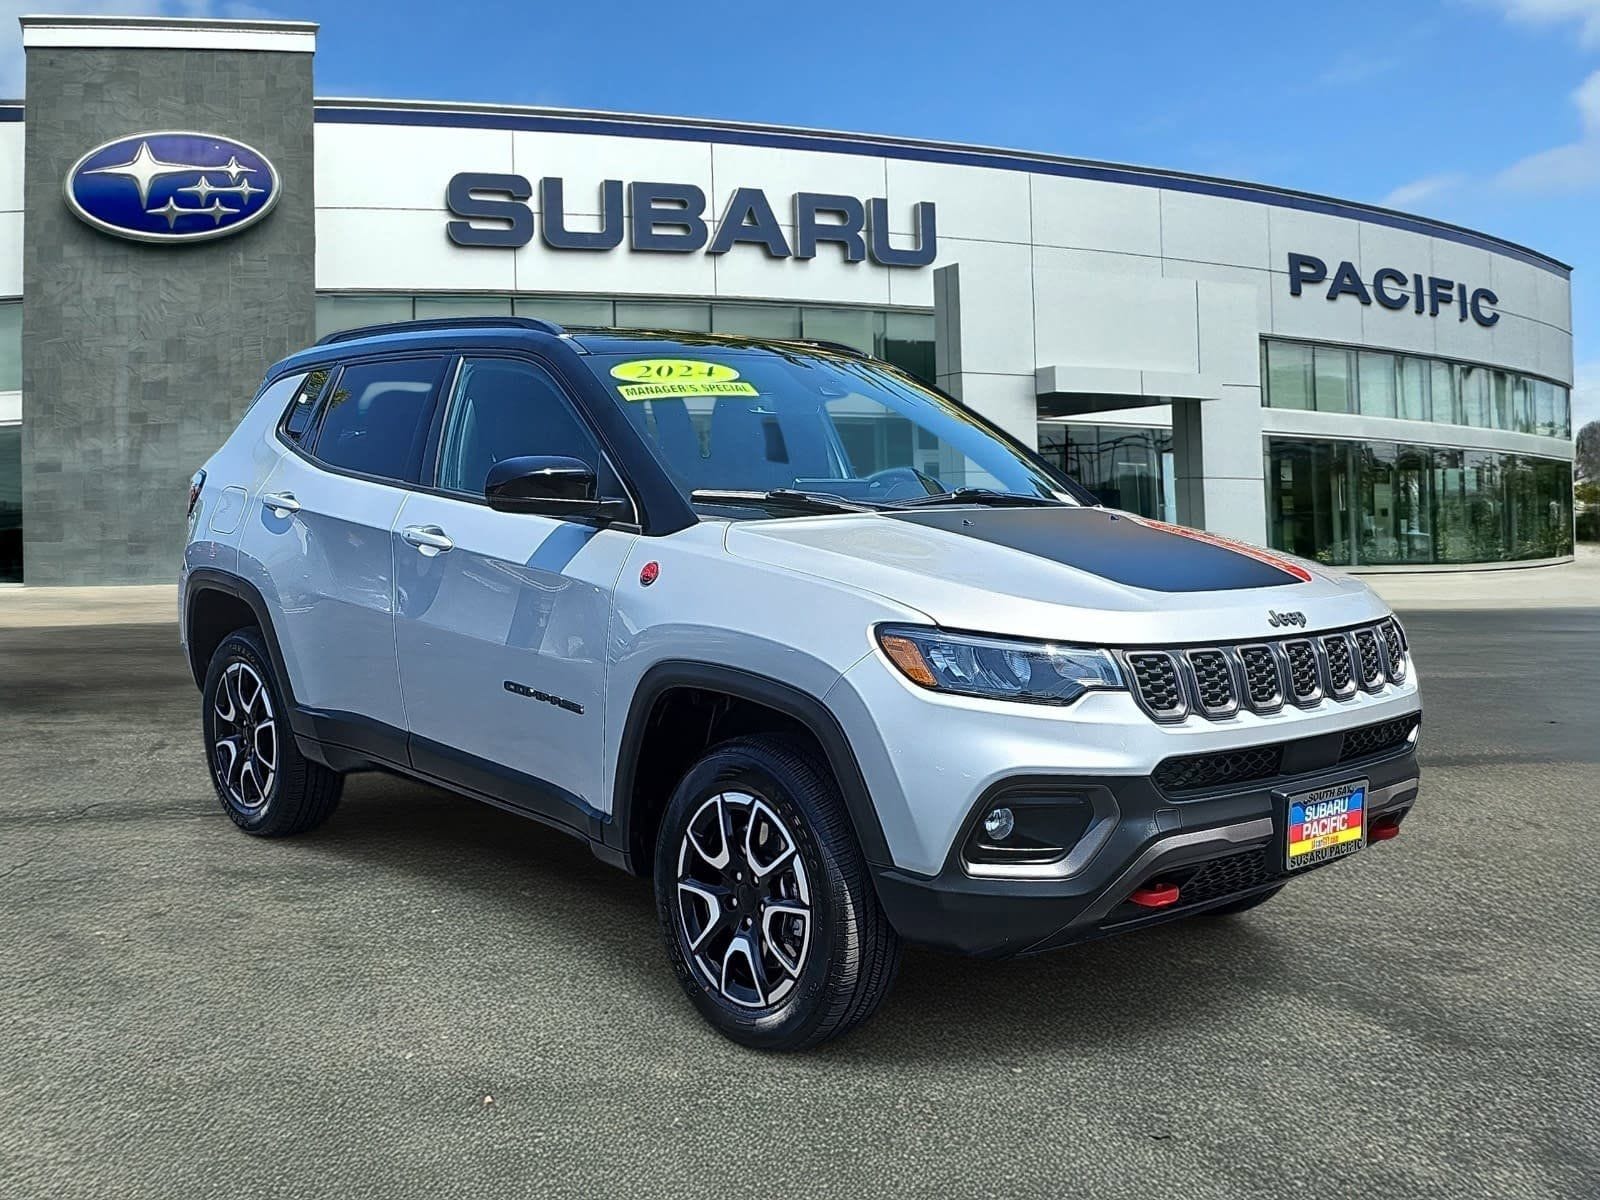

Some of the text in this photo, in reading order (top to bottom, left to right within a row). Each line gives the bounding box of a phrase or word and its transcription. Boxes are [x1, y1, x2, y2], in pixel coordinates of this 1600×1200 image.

[447, 171, 937, 267] SUBARU
[1287, 252, 1500, 327] PACIFIC
[636, 365, 716, 379] 2024
[625, 383, 751, 396] MANAGER'S SPECIAL
[1268, 609, 1307, 628] Jeep
[1308, 784, 1352, 803] SOUTH BAY
[1304, 797, 1348, 822] SUBARU
[1302, 814, 1348, 840] PACIFIC
[1290, 846, 1328, 868] SUBARU
[1329, 839, 1363, 857] PACIFIC
